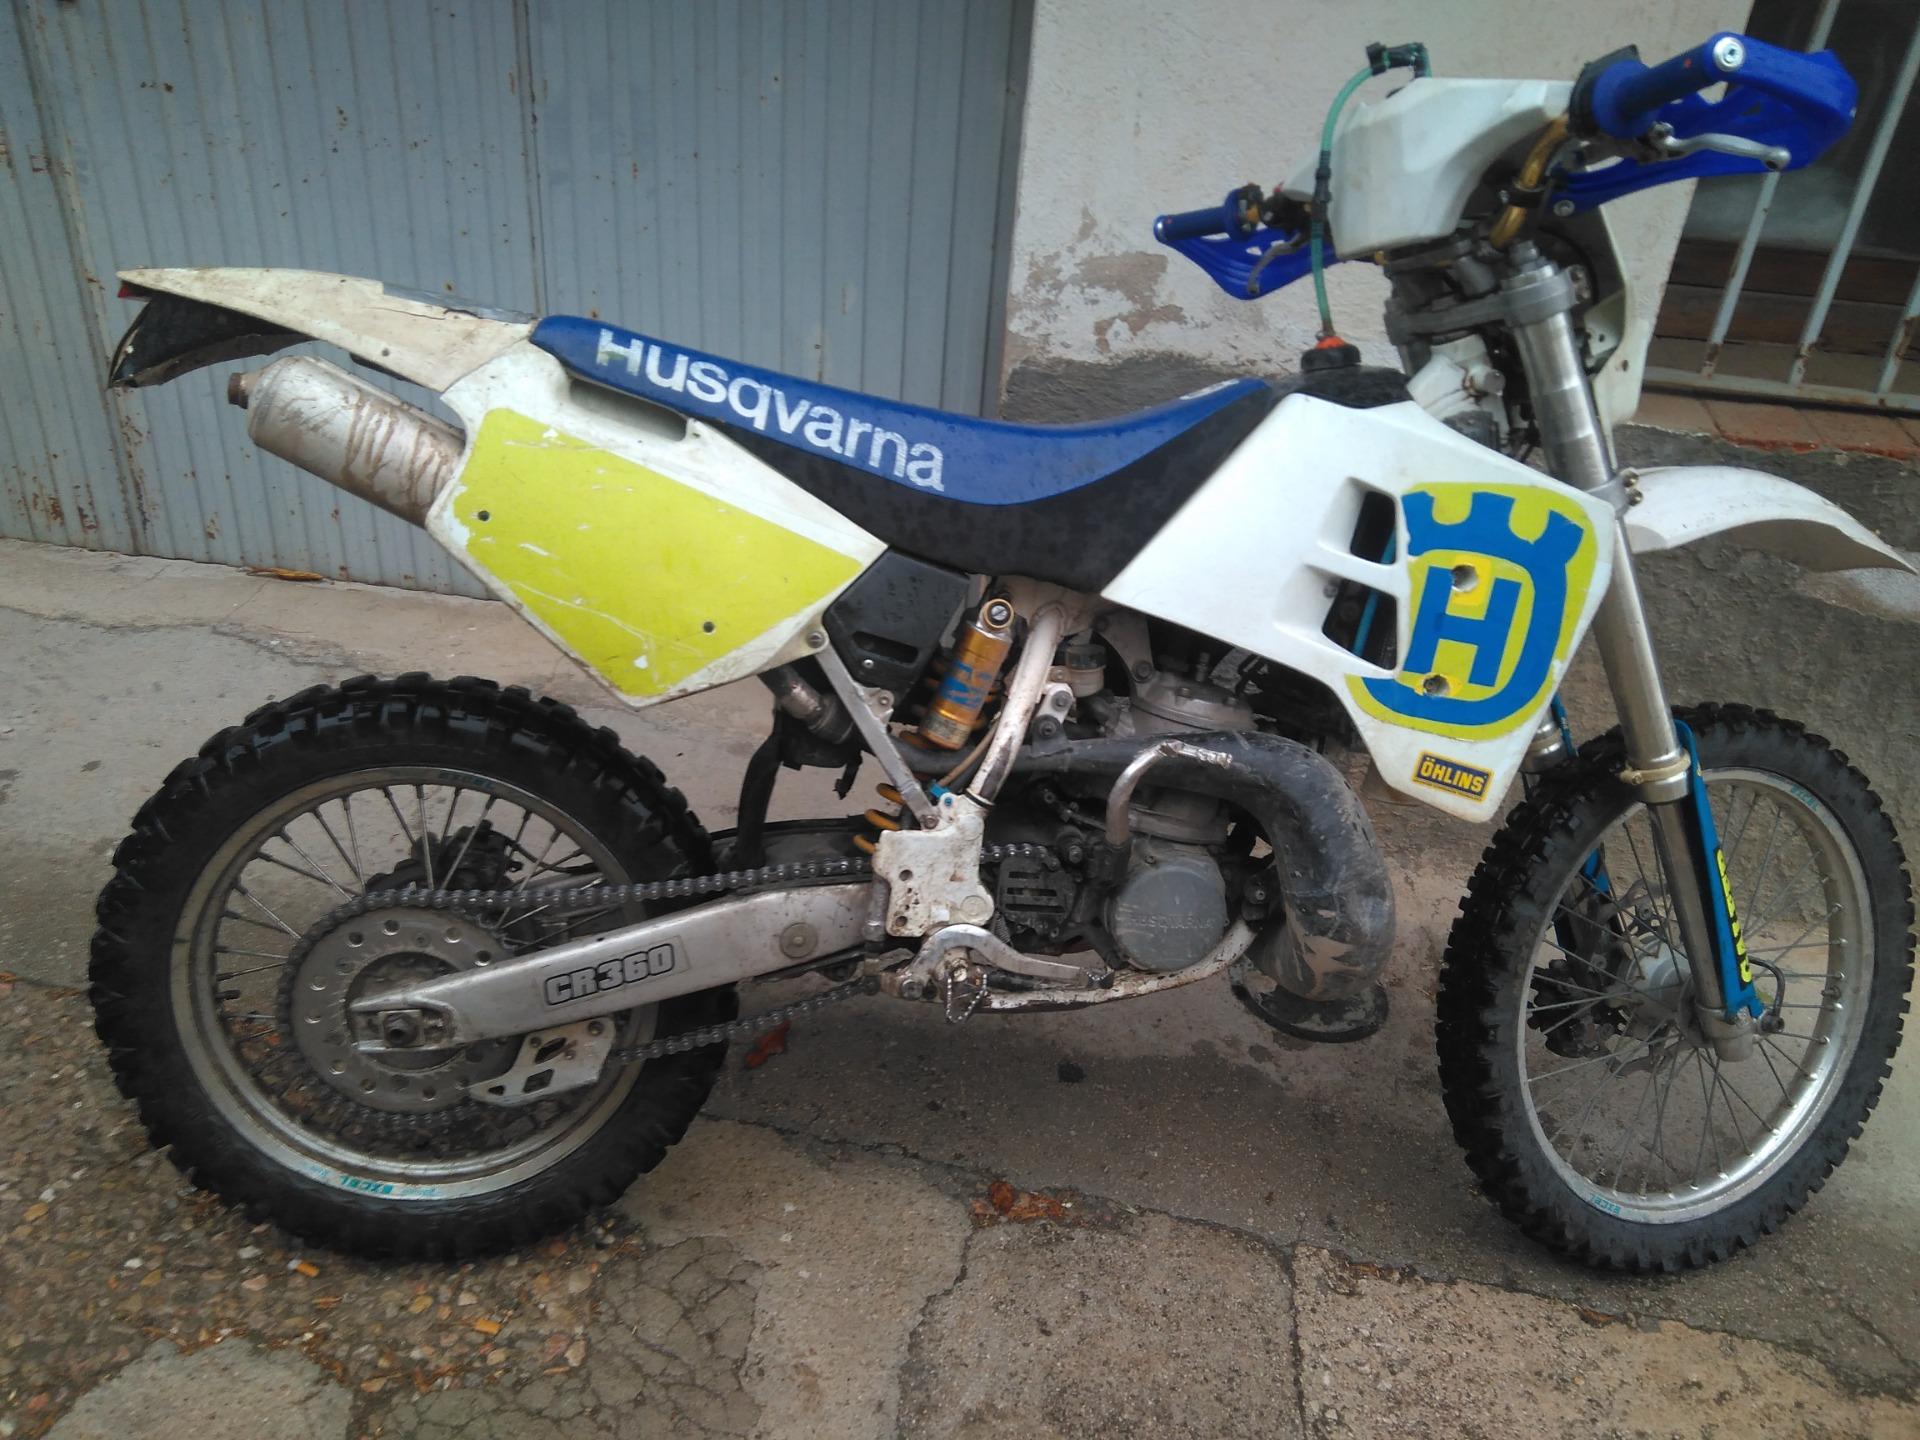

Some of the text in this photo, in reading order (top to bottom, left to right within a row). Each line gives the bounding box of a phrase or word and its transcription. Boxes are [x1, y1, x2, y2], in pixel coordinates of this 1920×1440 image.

[595, 328, 945, 492] Husqvarna
[1402, 565, 1523, 688] H
[1420, 756, 1485, 793] ÖHLINS
[544, 943, 675, 1006] CR360
